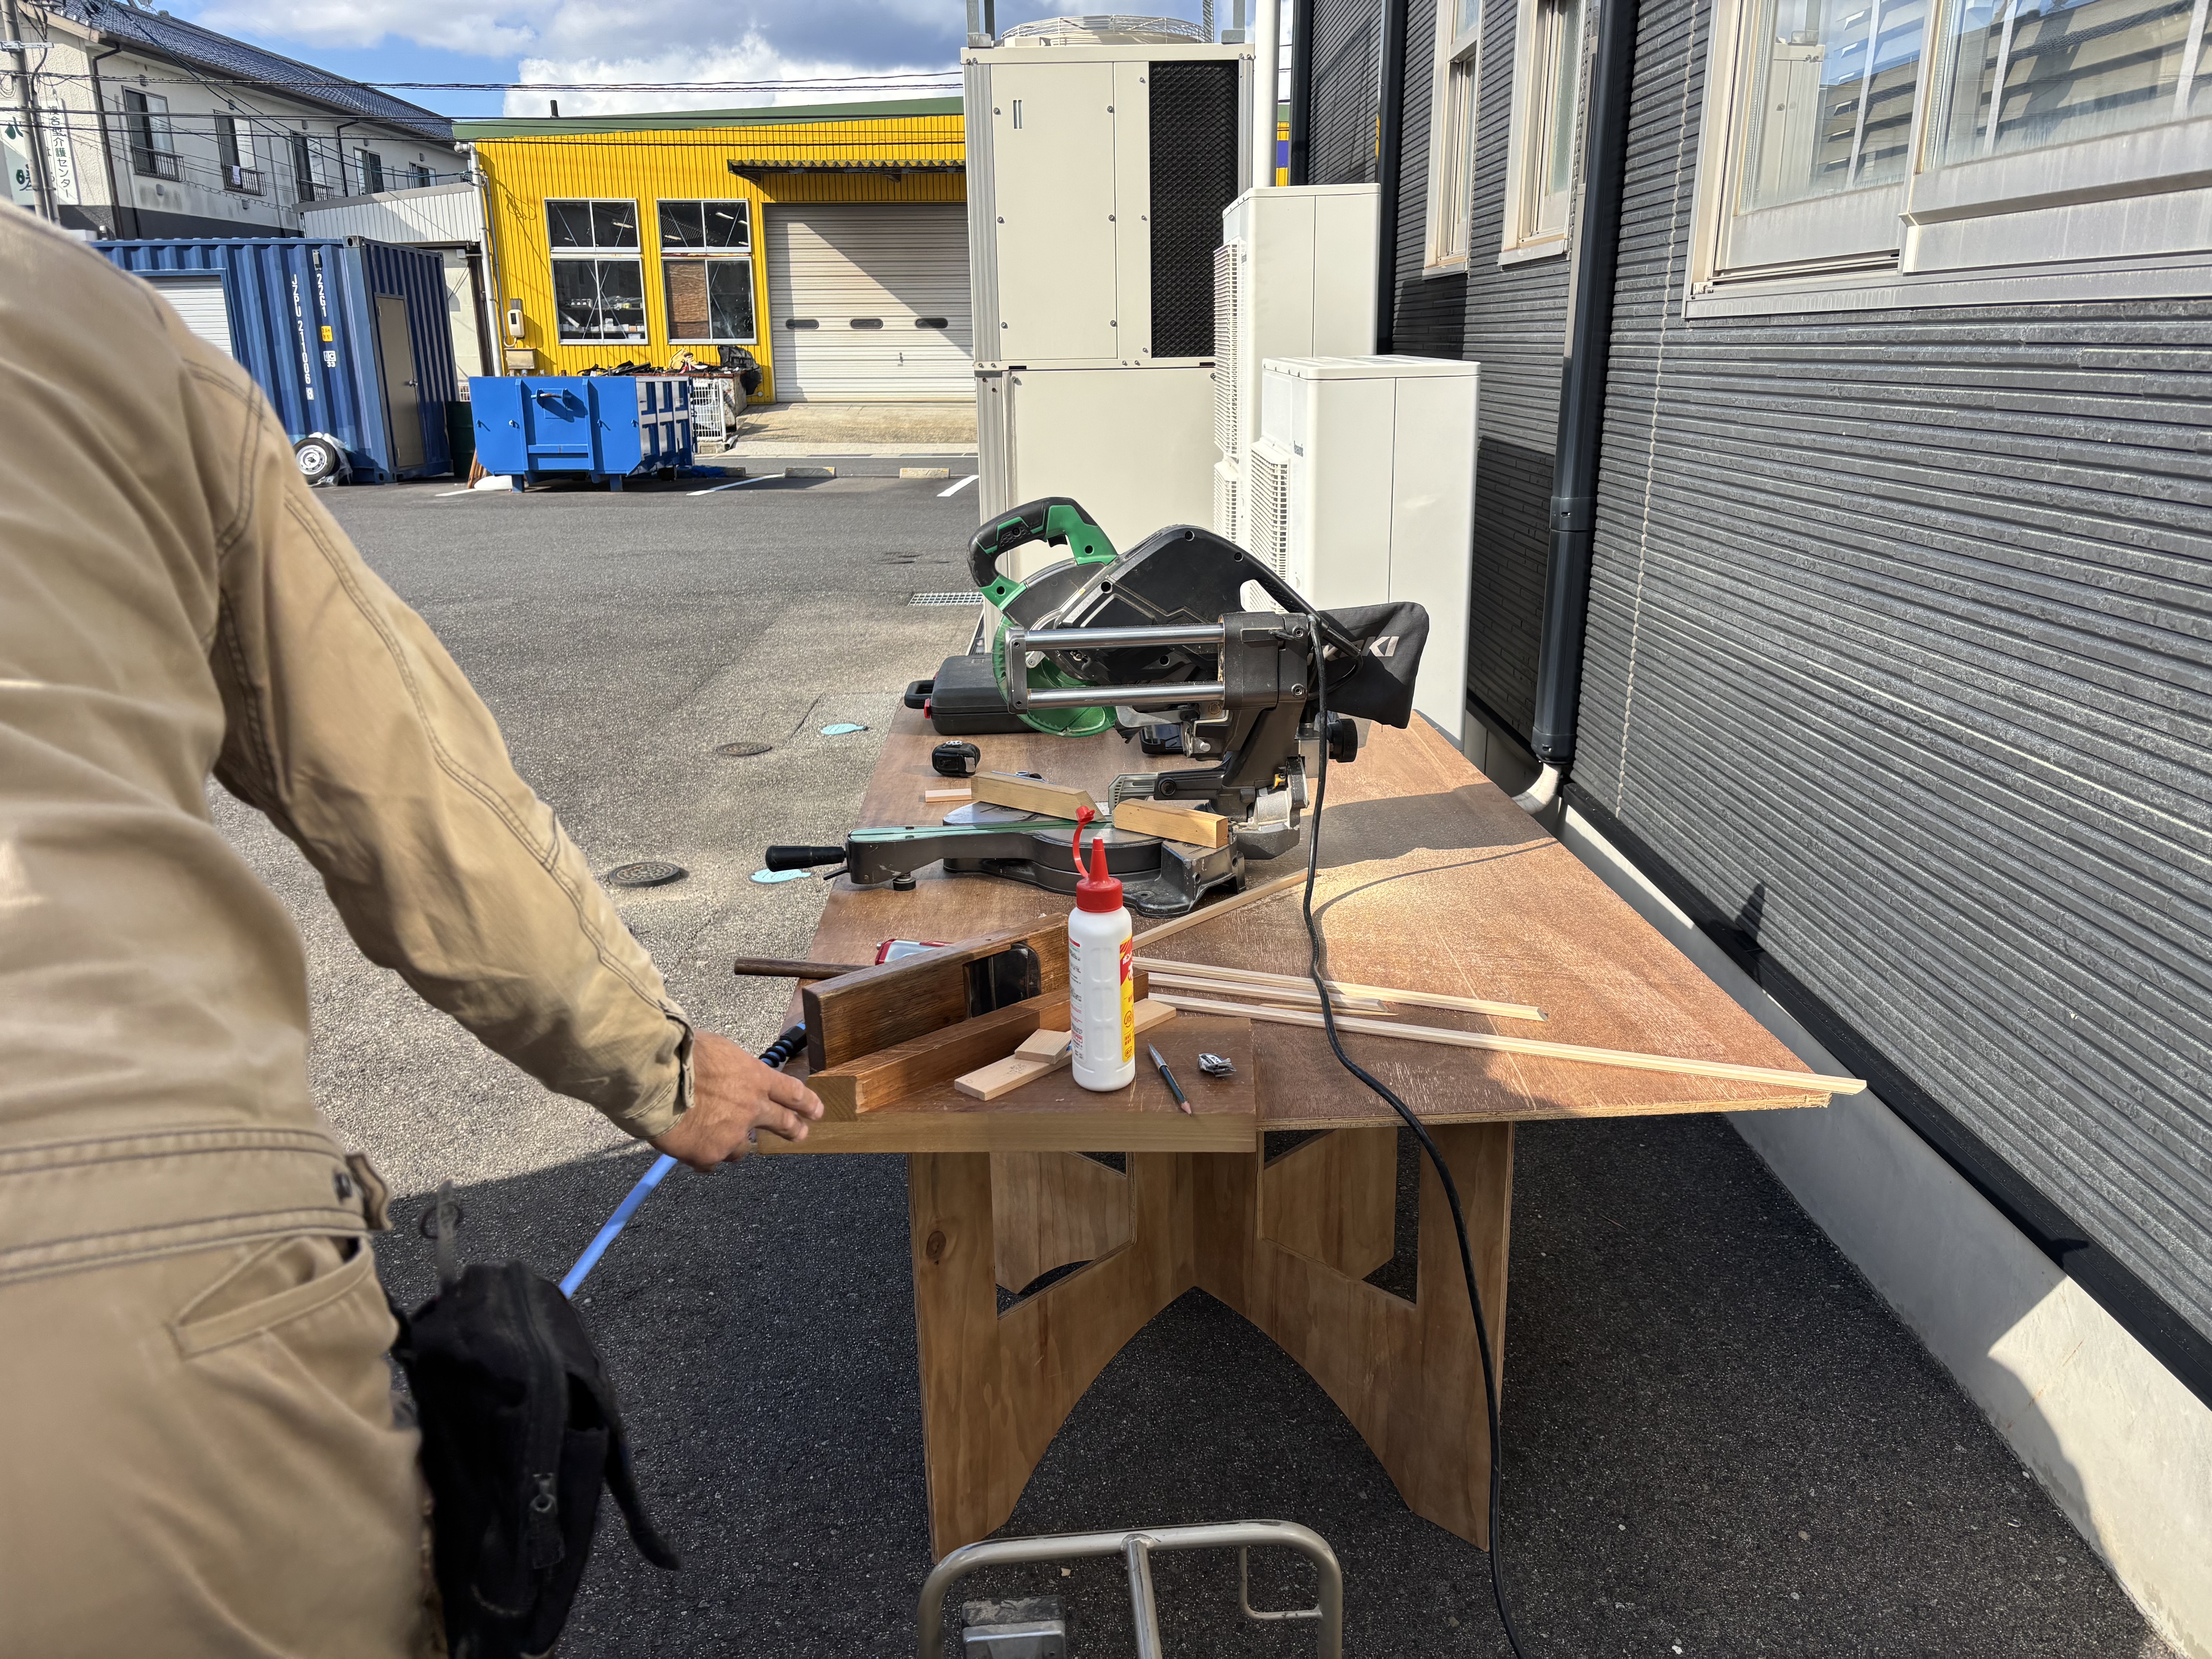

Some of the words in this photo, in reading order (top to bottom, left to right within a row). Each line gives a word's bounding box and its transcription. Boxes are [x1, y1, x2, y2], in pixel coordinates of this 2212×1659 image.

[292, 274, 301, 317] JZPU
[297, 320, 311, 384] 211006
[307, 388, 313, 399] 8
[317, 273, 326, 317] 22G1
